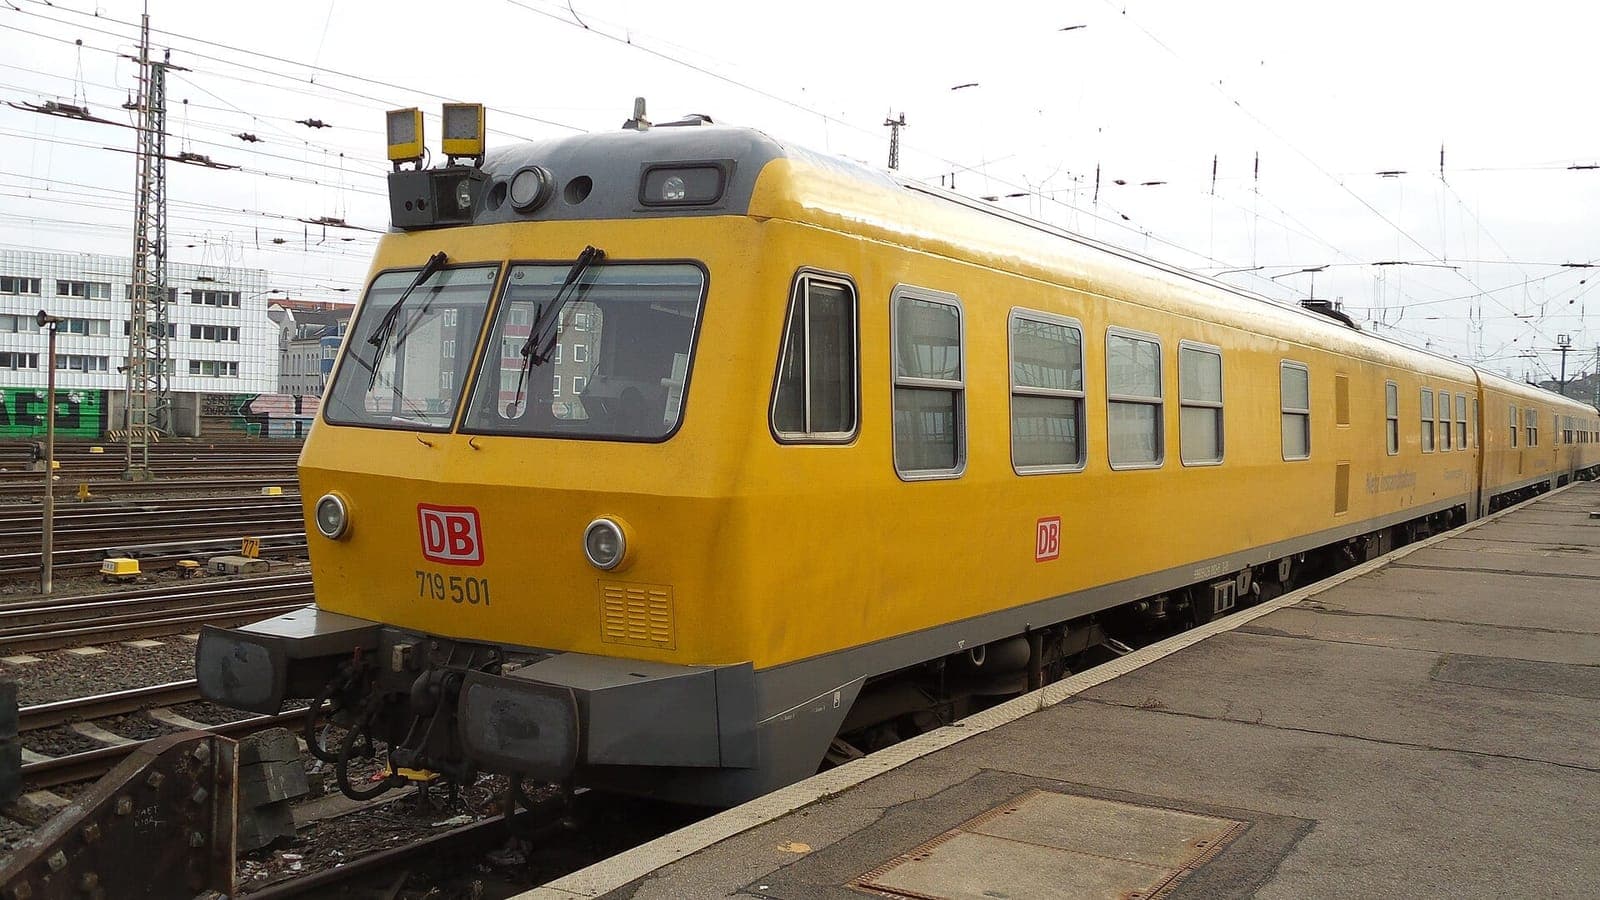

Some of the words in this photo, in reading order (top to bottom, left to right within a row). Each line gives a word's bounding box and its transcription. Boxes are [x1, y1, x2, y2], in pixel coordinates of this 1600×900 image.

[423, 512, 475, 556] DB
[1038, 523, 1058, 555] DB
[416, 570, 446, 601] 719
[449, 575, 490, 606] 501
